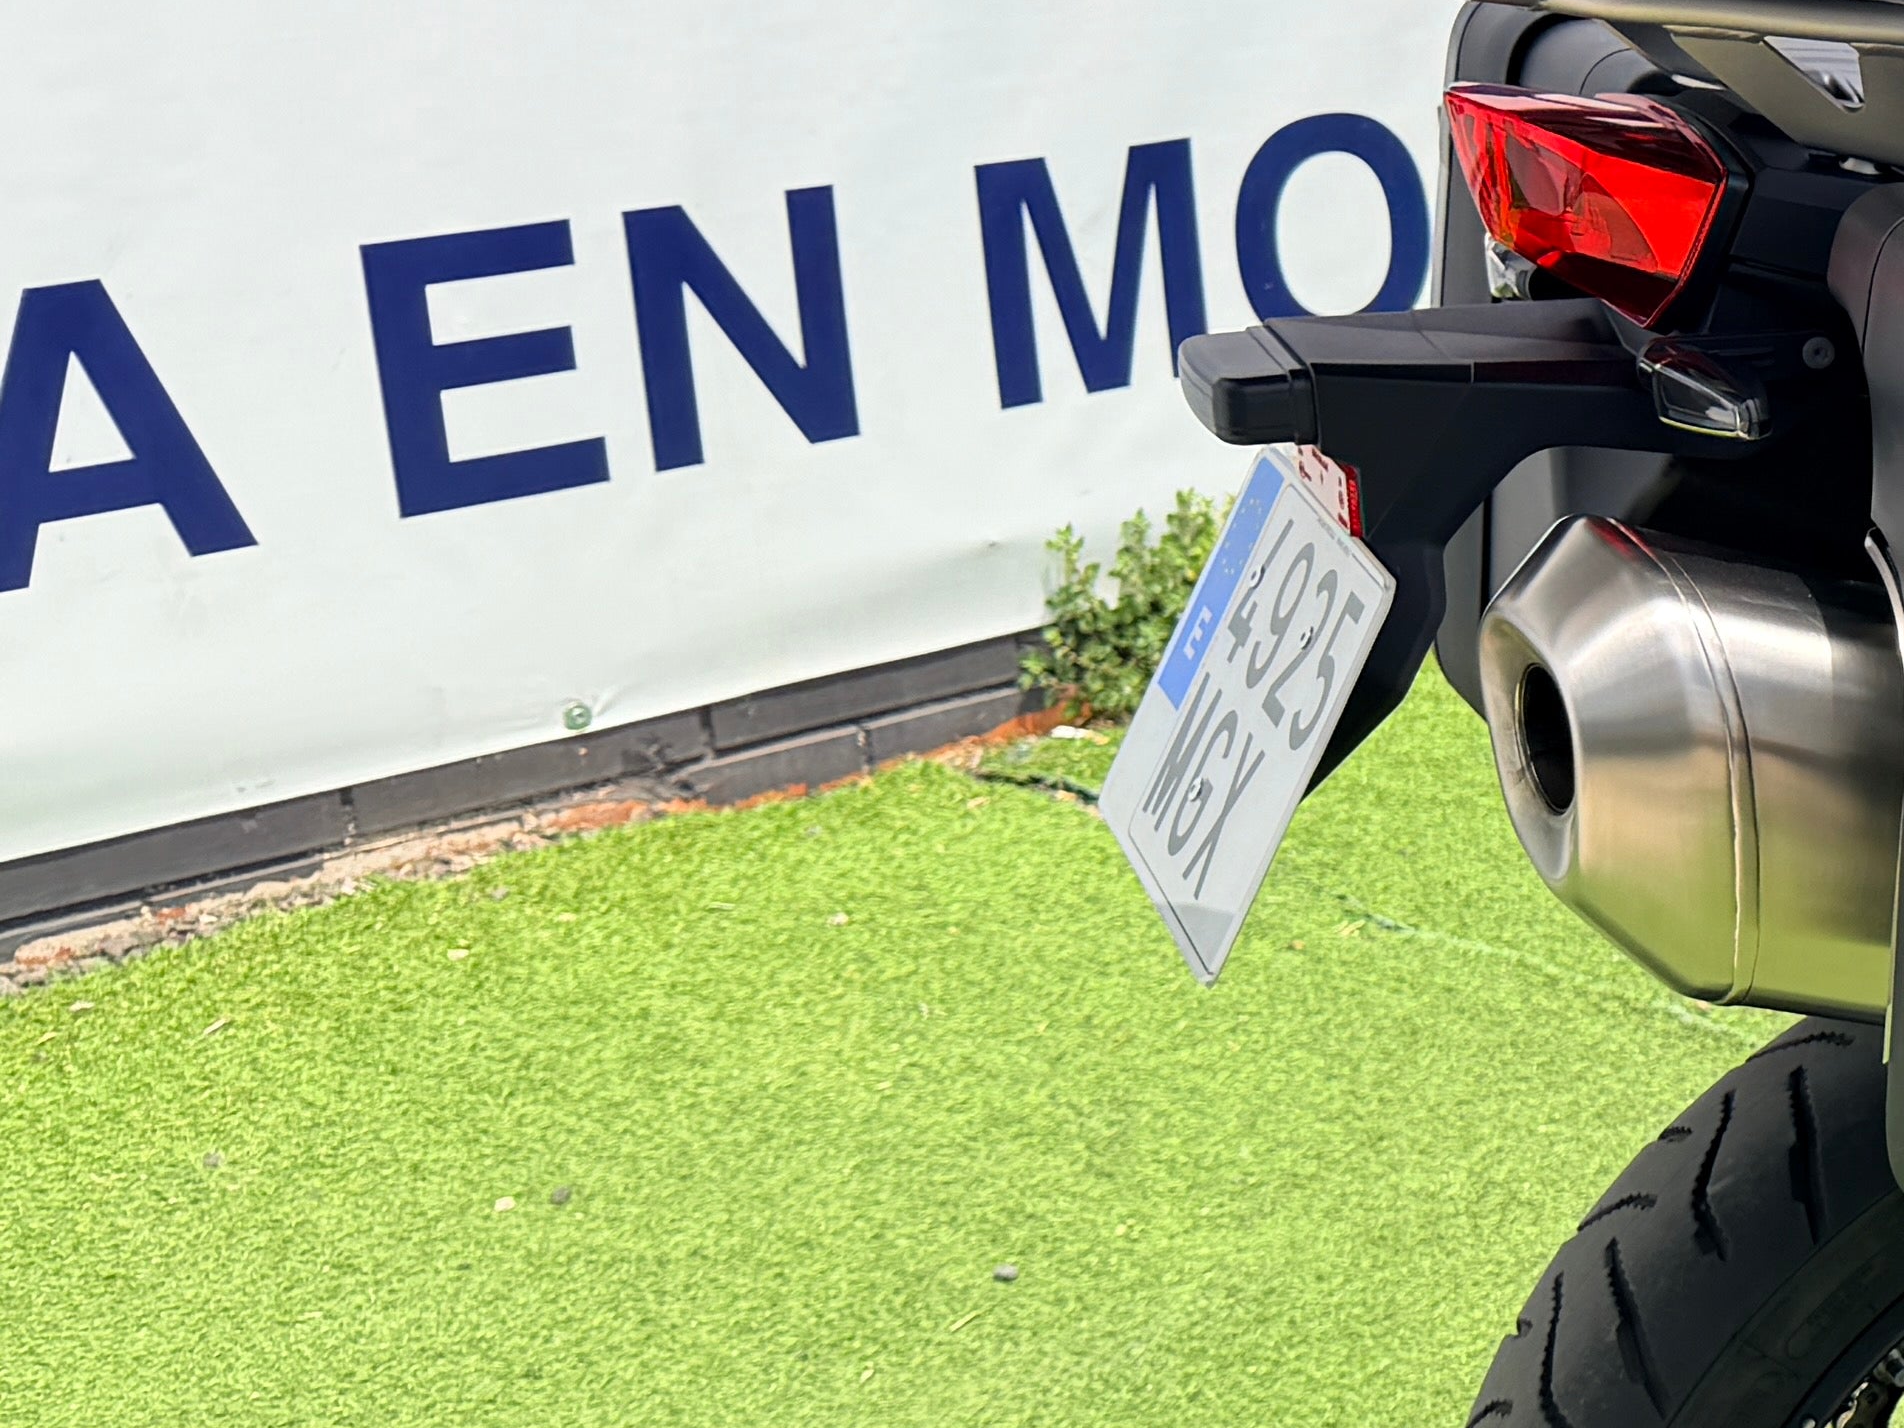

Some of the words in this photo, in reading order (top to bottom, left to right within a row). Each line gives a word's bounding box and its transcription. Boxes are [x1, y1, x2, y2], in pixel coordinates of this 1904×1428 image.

[360, 183, 863, 519] EN
[974, 111, 1431, 410] MO
[1184, 604, 1213, 661] E
[1227, 518, 1366, 753] 4925
[1142, 671, 1266, 901] MGX
